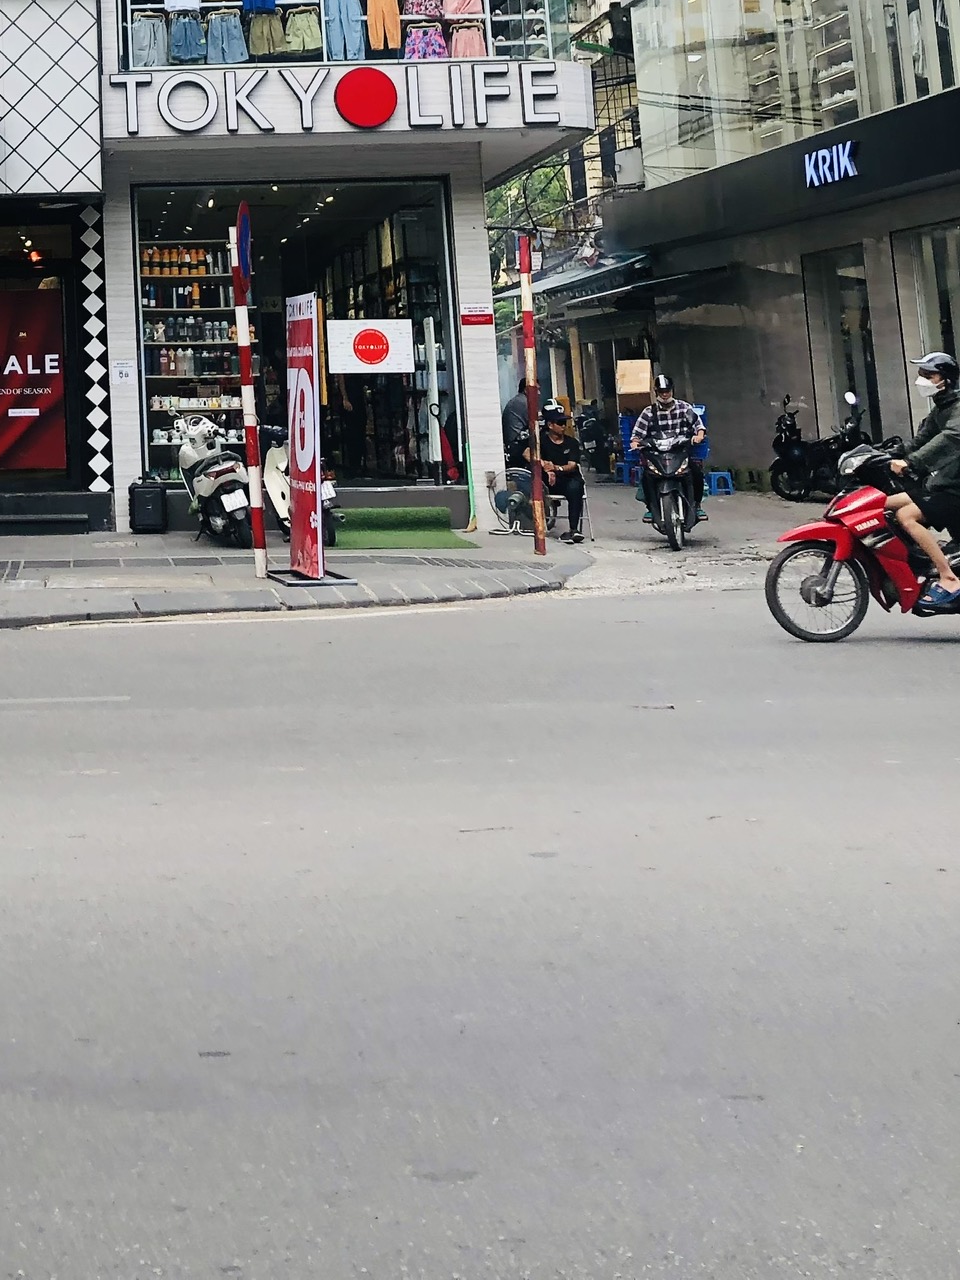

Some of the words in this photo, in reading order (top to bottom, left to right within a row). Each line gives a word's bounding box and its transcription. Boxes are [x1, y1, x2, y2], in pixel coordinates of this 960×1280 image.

[804, 140, 858, 188] KRIK
[23, 387, 52, 395] SEASON
[854, 518, 880, 532] YAMAHA
